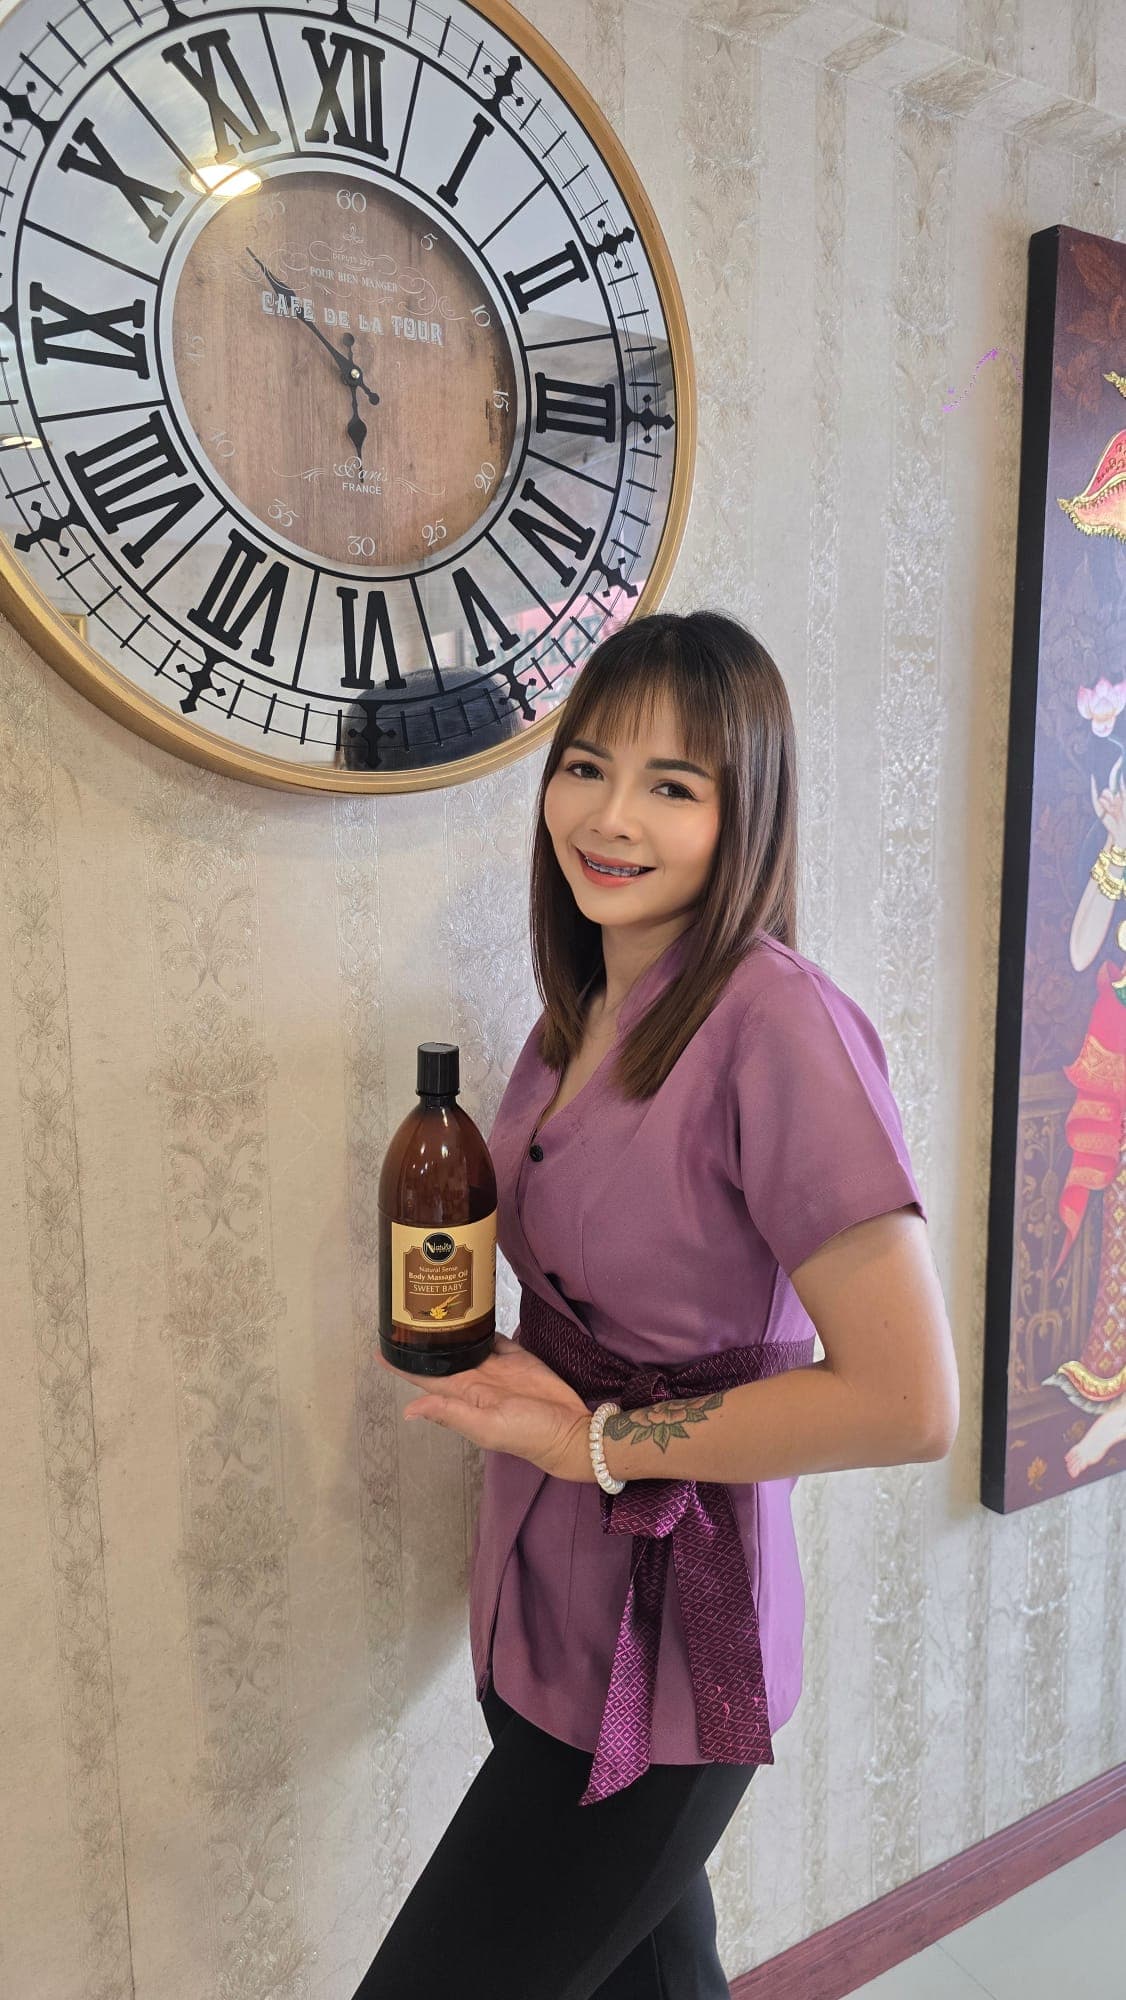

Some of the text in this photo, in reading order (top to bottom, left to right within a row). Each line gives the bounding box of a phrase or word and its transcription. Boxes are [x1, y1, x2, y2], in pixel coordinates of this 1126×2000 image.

[161, 29, 281, 163] XI
[302, 27, 389, 160] XII
[57, 117, 185, 243] X
[336, 189, 367, 213] 60
[420, 233, 439, 251] 5
[310, 266, 398, 293] POUR BIEN MANGER
[503, 240, 588, 313] II
[30, 282, 150, 380] IX
[324, 307, 350, 328] DE
[359, 314, 384, 335] LA
[391, 315, 443, 346] TOUR
[470, 304, 491, 328] 10
[493, 390, 510, 413] 15
[535, 372, 615, 443] III
[333, 456, 388, 482] Paris
[474, 461, 497, 494] 20
[65, 410, 204, 569] VIII
[342, 482, 382, 496] FRANCE
[267, 498, 300, 528] 35
[347, 535, 376, 557] 30
[421, 518, 447, 547] 25
[509, 478, 595, 587] IV
[187, 529, 289, 667] VII
[337, 586, 407, 689] VI
[408, 1269, 468, 1282] Body Massage Oil
[413, 1282, 463, 1293] SWEET BABY
